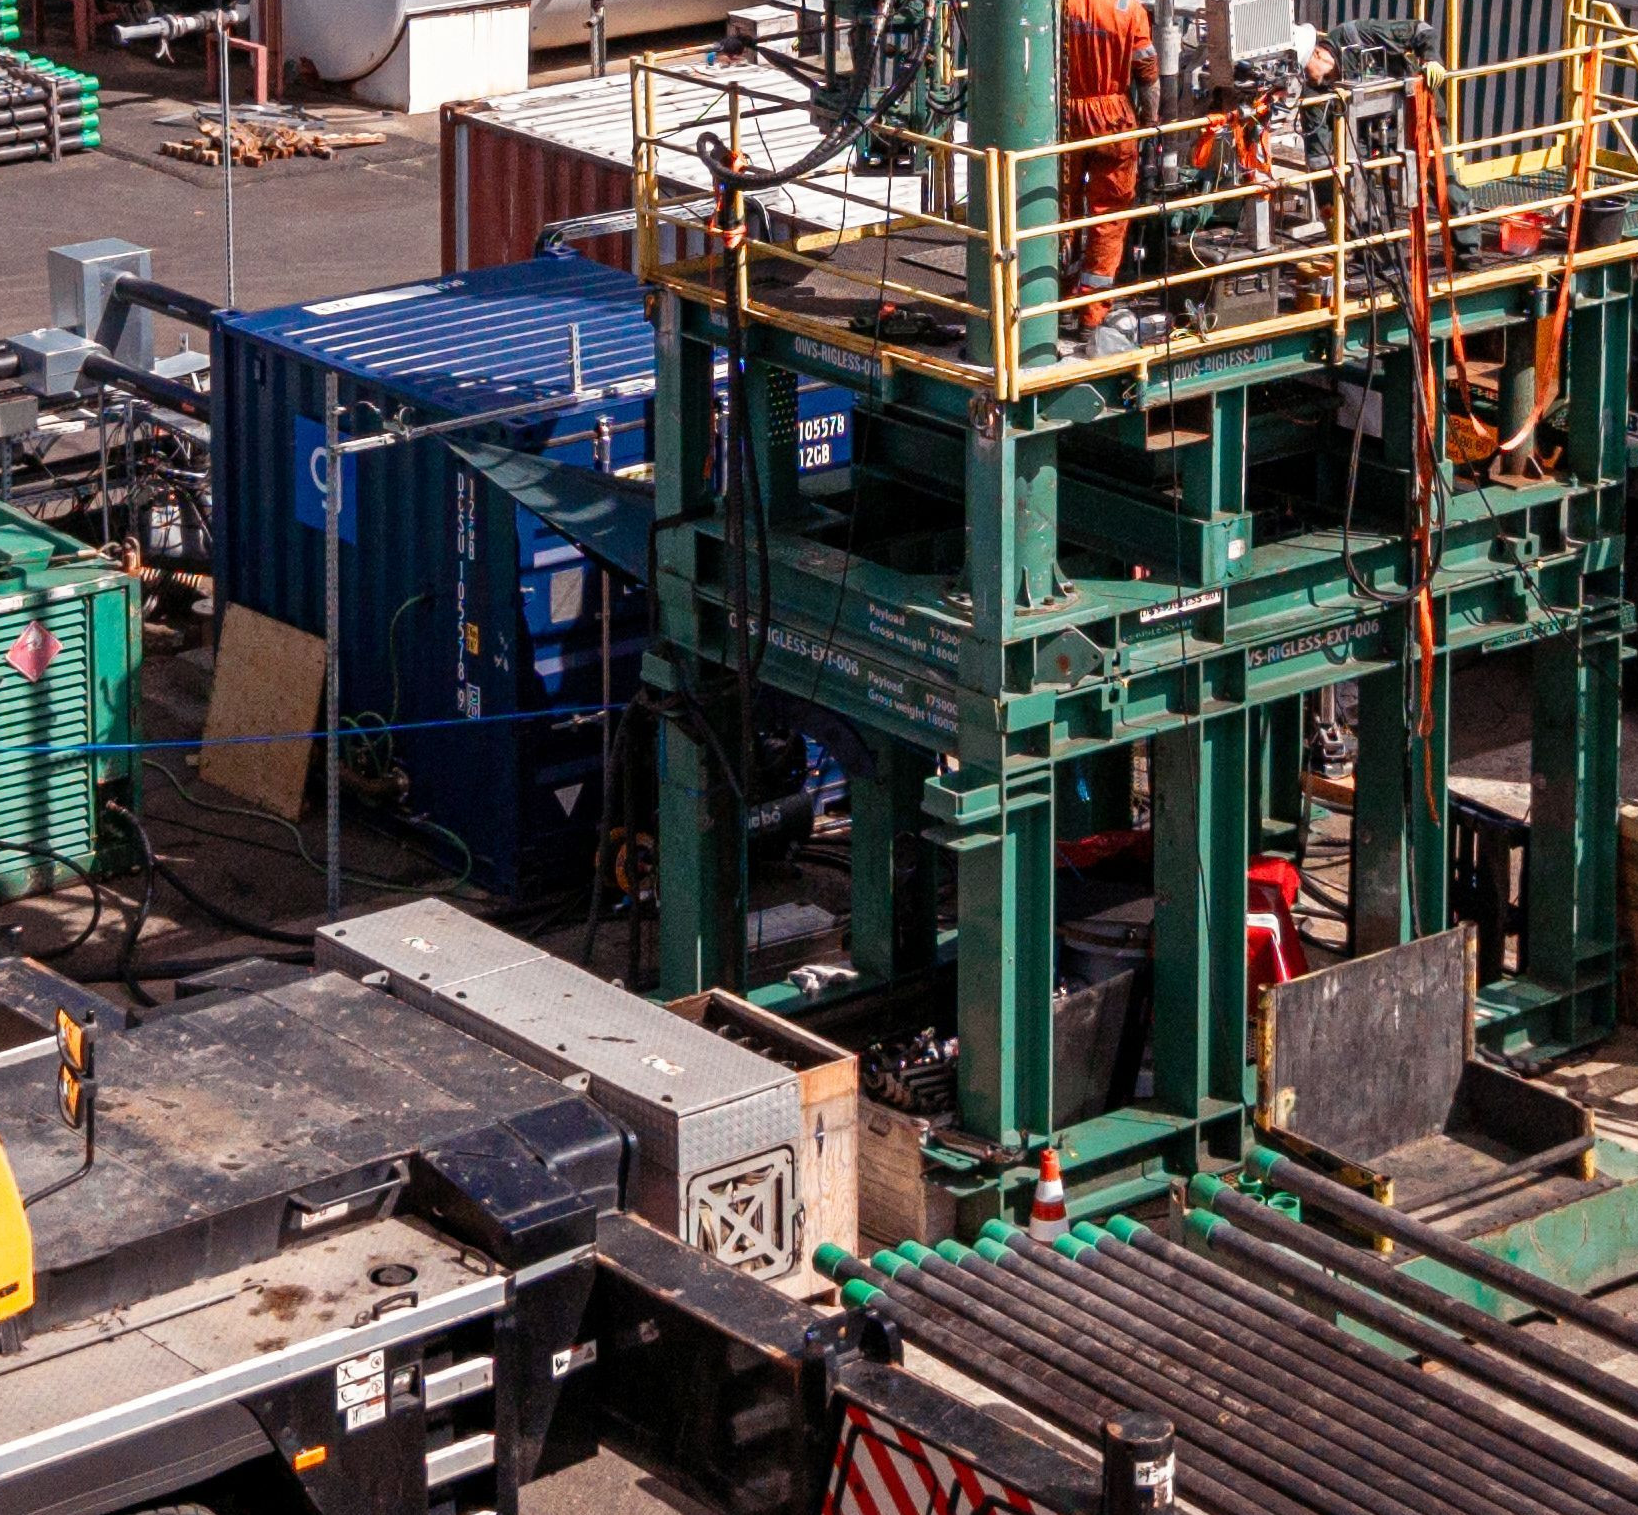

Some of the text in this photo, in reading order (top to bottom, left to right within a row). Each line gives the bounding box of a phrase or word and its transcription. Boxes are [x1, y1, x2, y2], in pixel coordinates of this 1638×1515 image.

[1173, 343, 1273, 380] OWS-RIGLESS-001
[799, 413, 845, 442] 105578
[869, 603, 905, 627] Payload
[729, 612, 859, 676] OS-IGLESS-EXT-006
[1248, 618, 1379, 668] WS-RIGLESS-EXT-006
[868, 670, 904, 695] Payload
